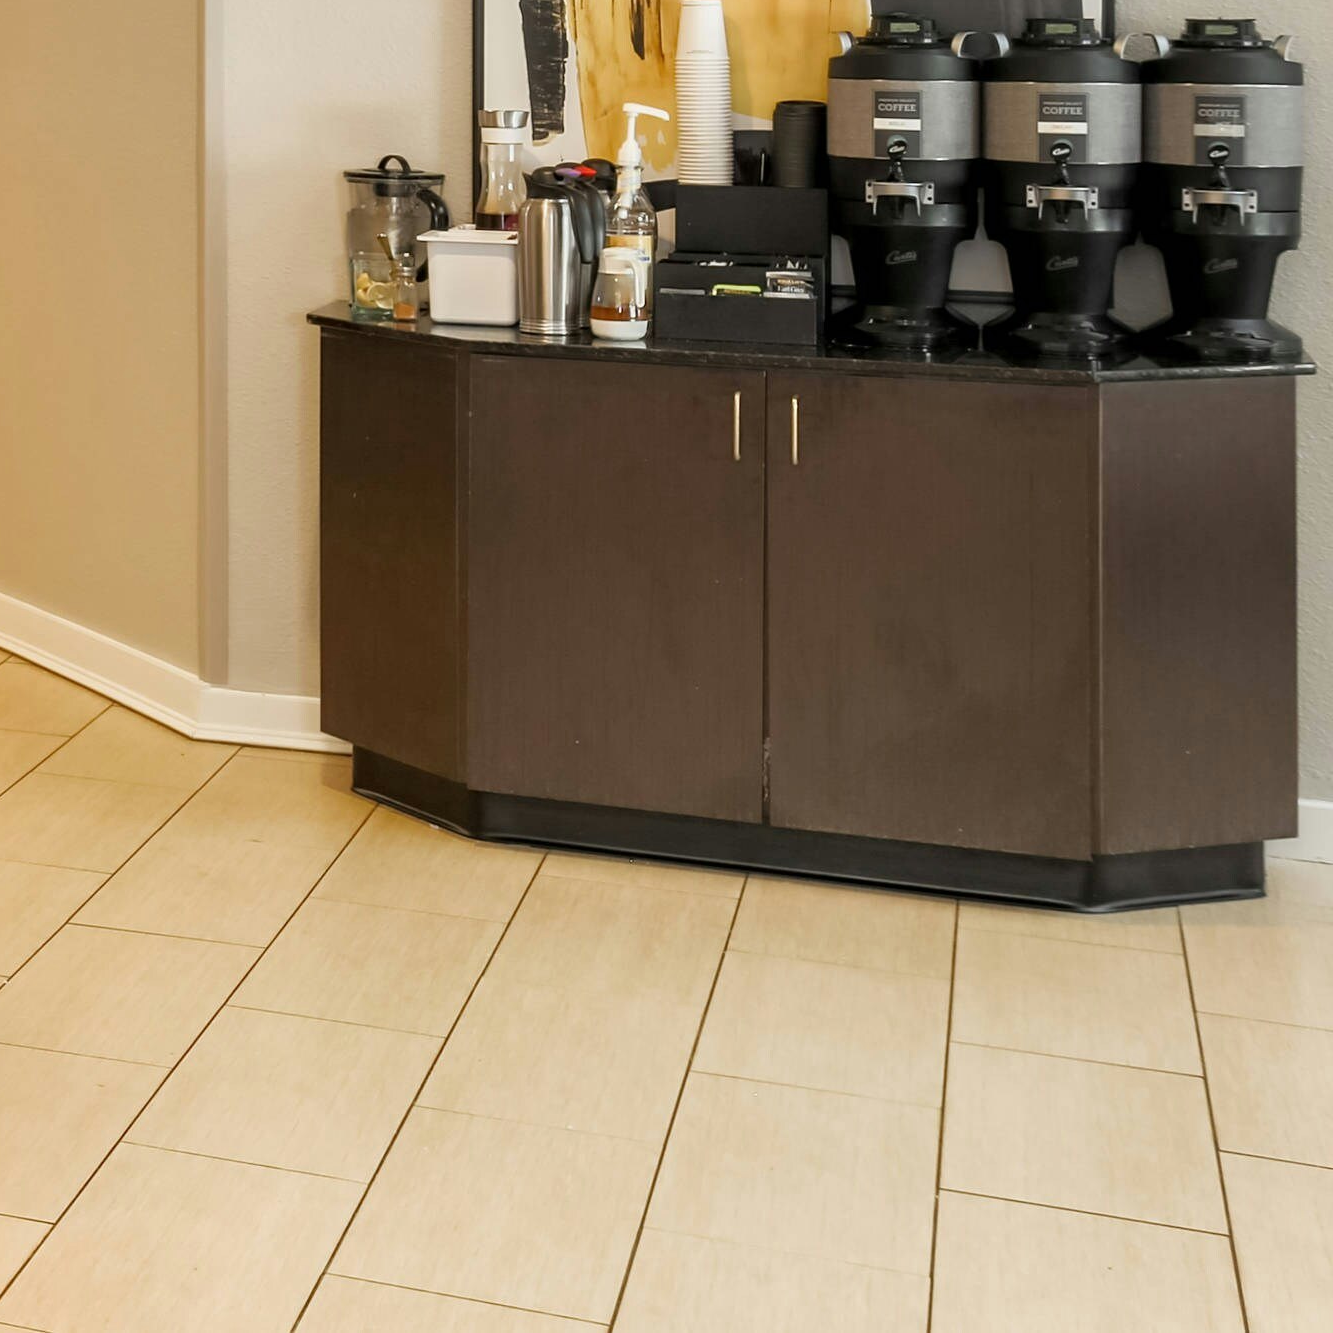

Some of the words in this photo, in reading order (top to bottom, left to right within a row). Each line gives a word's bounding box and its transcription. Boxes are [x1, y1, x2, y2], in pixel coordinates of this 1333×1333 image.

[878, 103, 917, 113] COFFEE
[1042, 106, 1083, 116] COFFEE
[1197, 108, 1241, 119] COFFEE
